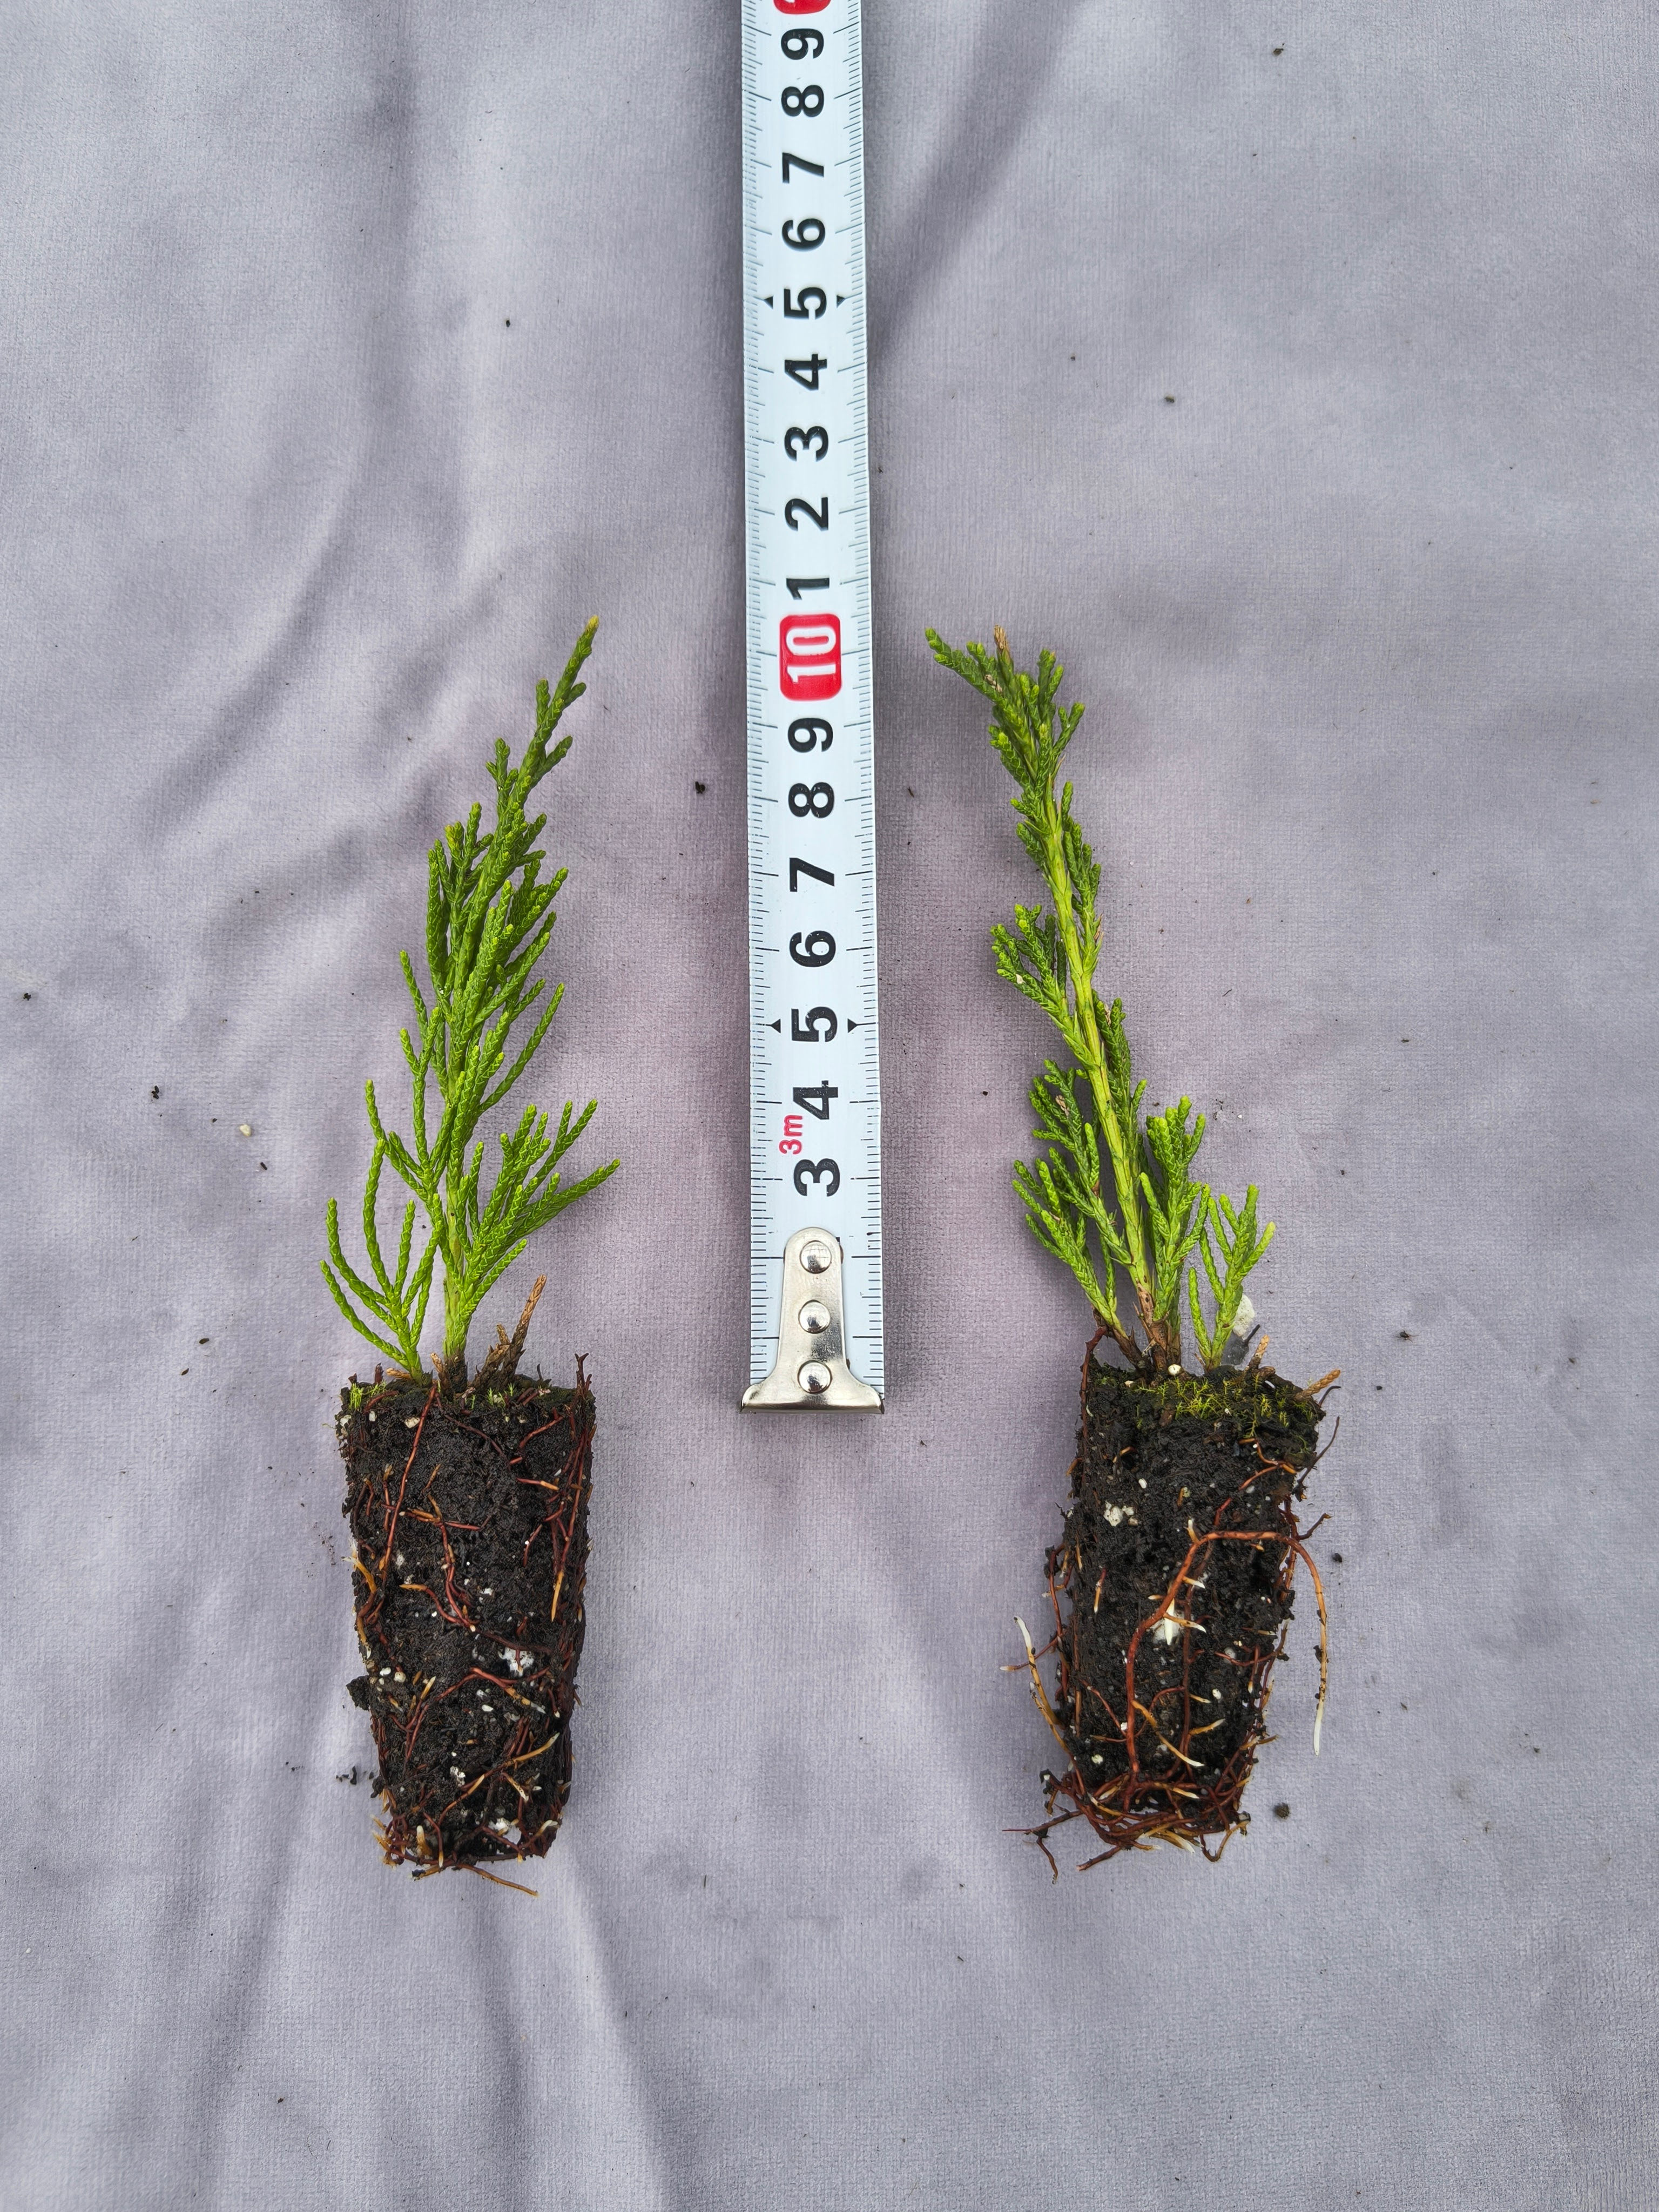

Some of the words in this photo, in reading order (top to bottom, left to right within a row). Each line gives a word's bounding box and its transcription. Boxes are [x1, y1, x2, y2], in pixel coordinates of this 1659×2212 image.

[781, 28, 824, 60] 9
[781, 85, 824, 117] 8
[782, 152, 824, 184] 7
[782, 218, 825, 252] 6
[784, 287, 827, 320] 5
[784, 354, 827, 391] 4
[784, 426, 829, 462] 3
[785, 497, 829, 531] 2
[786, 577, 830, 601] 1
[786, 626, 837, 683] 10
[787, 718, 833, 753] 9
[788, 782, 834, 818] 8
[790, 858, 834, 892] 7
[789, 930, 836, 968] 6
[791, 1007, 838, 1042] 5
[793, 1080, 838, 1120] 4
[778, 1114, 802, 1155] 3m
[793, 1158, 840, 1197] 3
